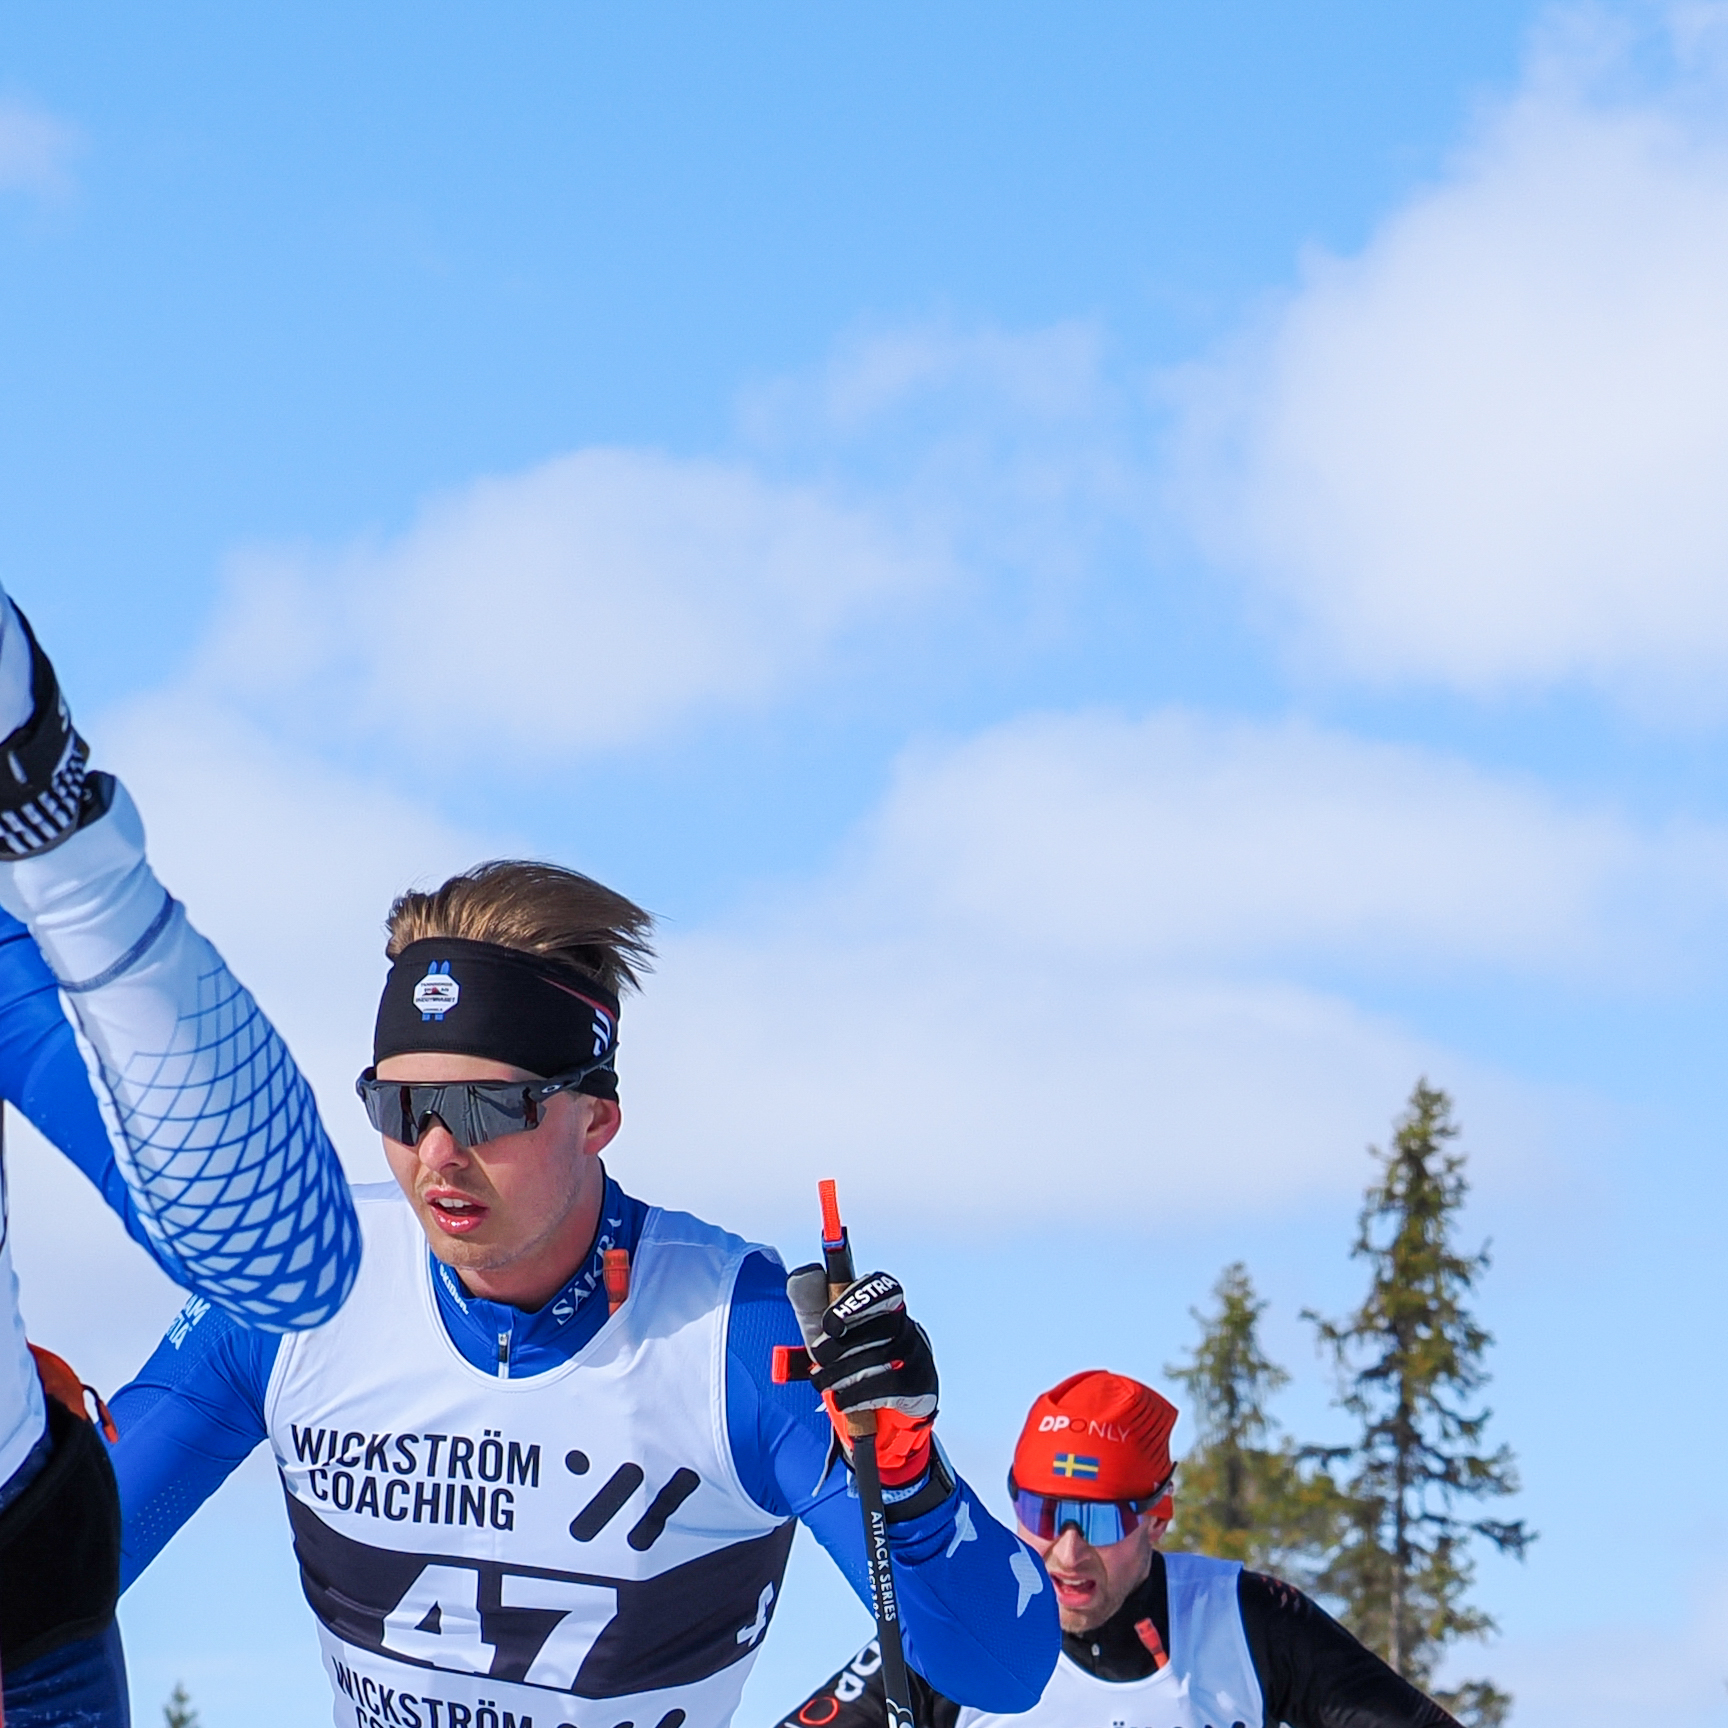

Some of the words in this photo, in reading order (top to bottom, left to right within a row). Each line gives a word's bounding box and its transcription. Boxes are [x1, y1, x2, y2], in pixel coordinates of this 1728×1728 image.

[832, 1275, 899, 1319] HESTRA
[290, 1423, 541, 1488] WICKSTRÖM
[1038, 1415, 1130, 1443] DPONLY
[309, 1469, 516, 1532] COACHING
[870, 1510, 890, 1571] ATTACK
[381, 1563, 619, 1691] 47
[879, 1573, 897, 1622] SERIES
